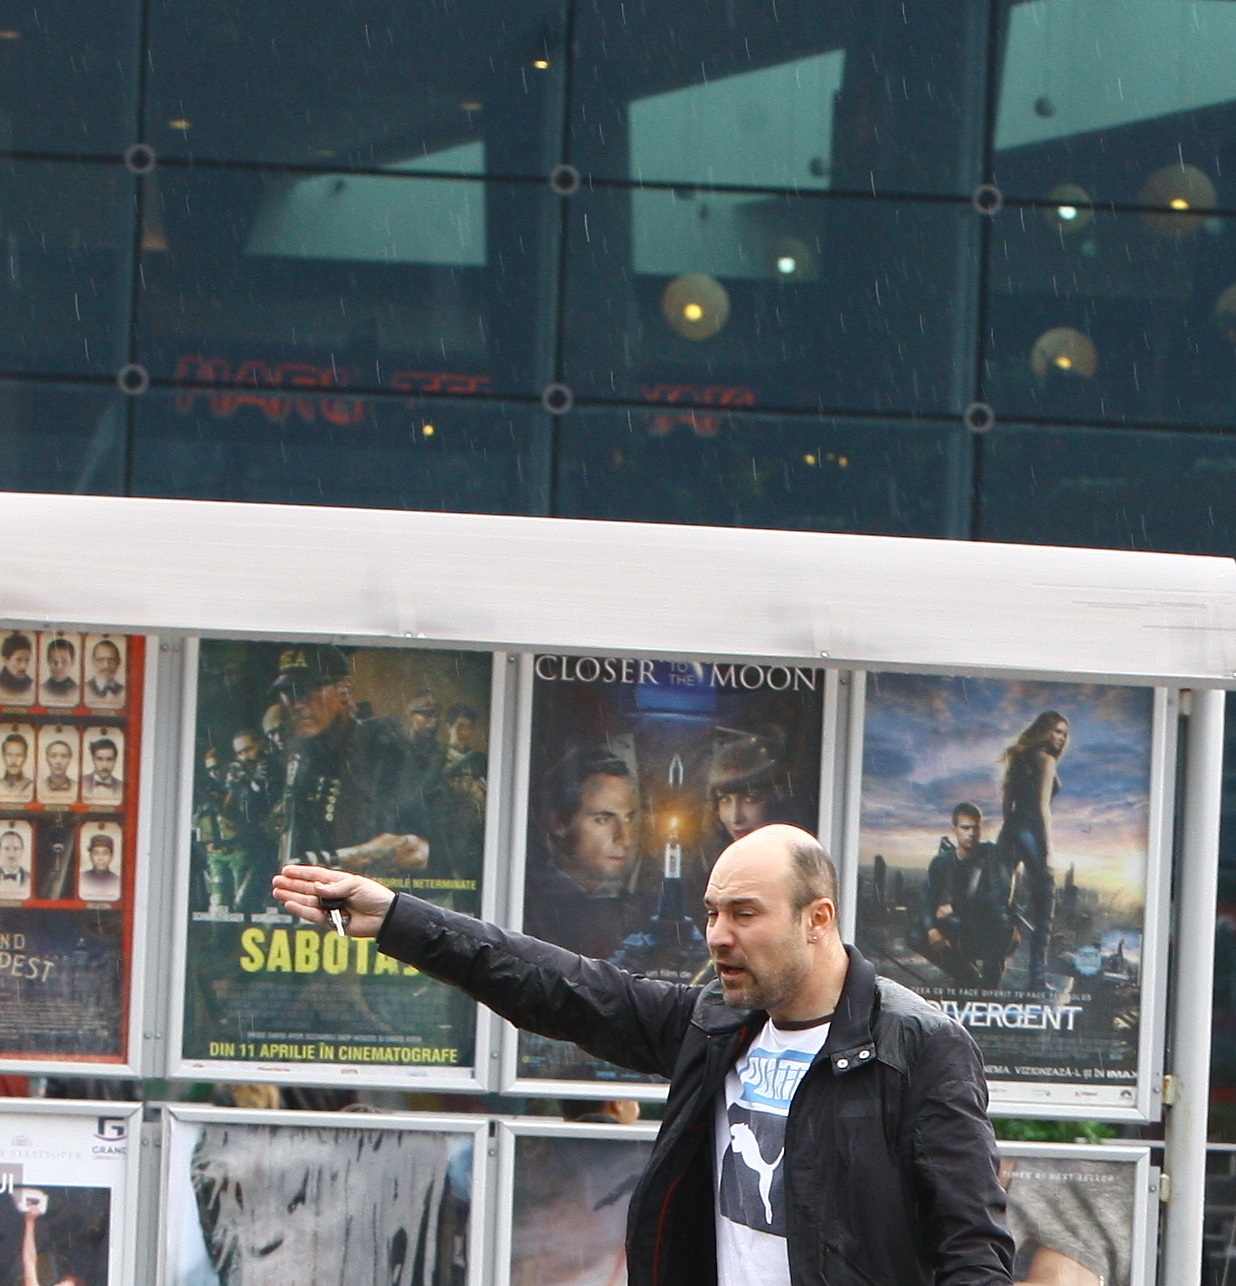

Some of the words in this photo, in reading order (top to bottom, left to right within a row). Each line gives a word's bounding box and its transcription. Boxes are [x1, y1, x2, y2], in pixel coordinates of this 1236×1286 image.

[535, 654, 660, 685] CLOSER
[709, 664, 817, 691] MOON
[669, 673, 694, 686] THE
[210, 1042, 236, 1056] DIN
[239, 1043, 255, 1057] 11
[260, 1043, 315, 1059] APRILIE
[320, 1042, 334, 1060] ÎN
[338, 1045, 459, 1063] CINEMATOGRAFE
